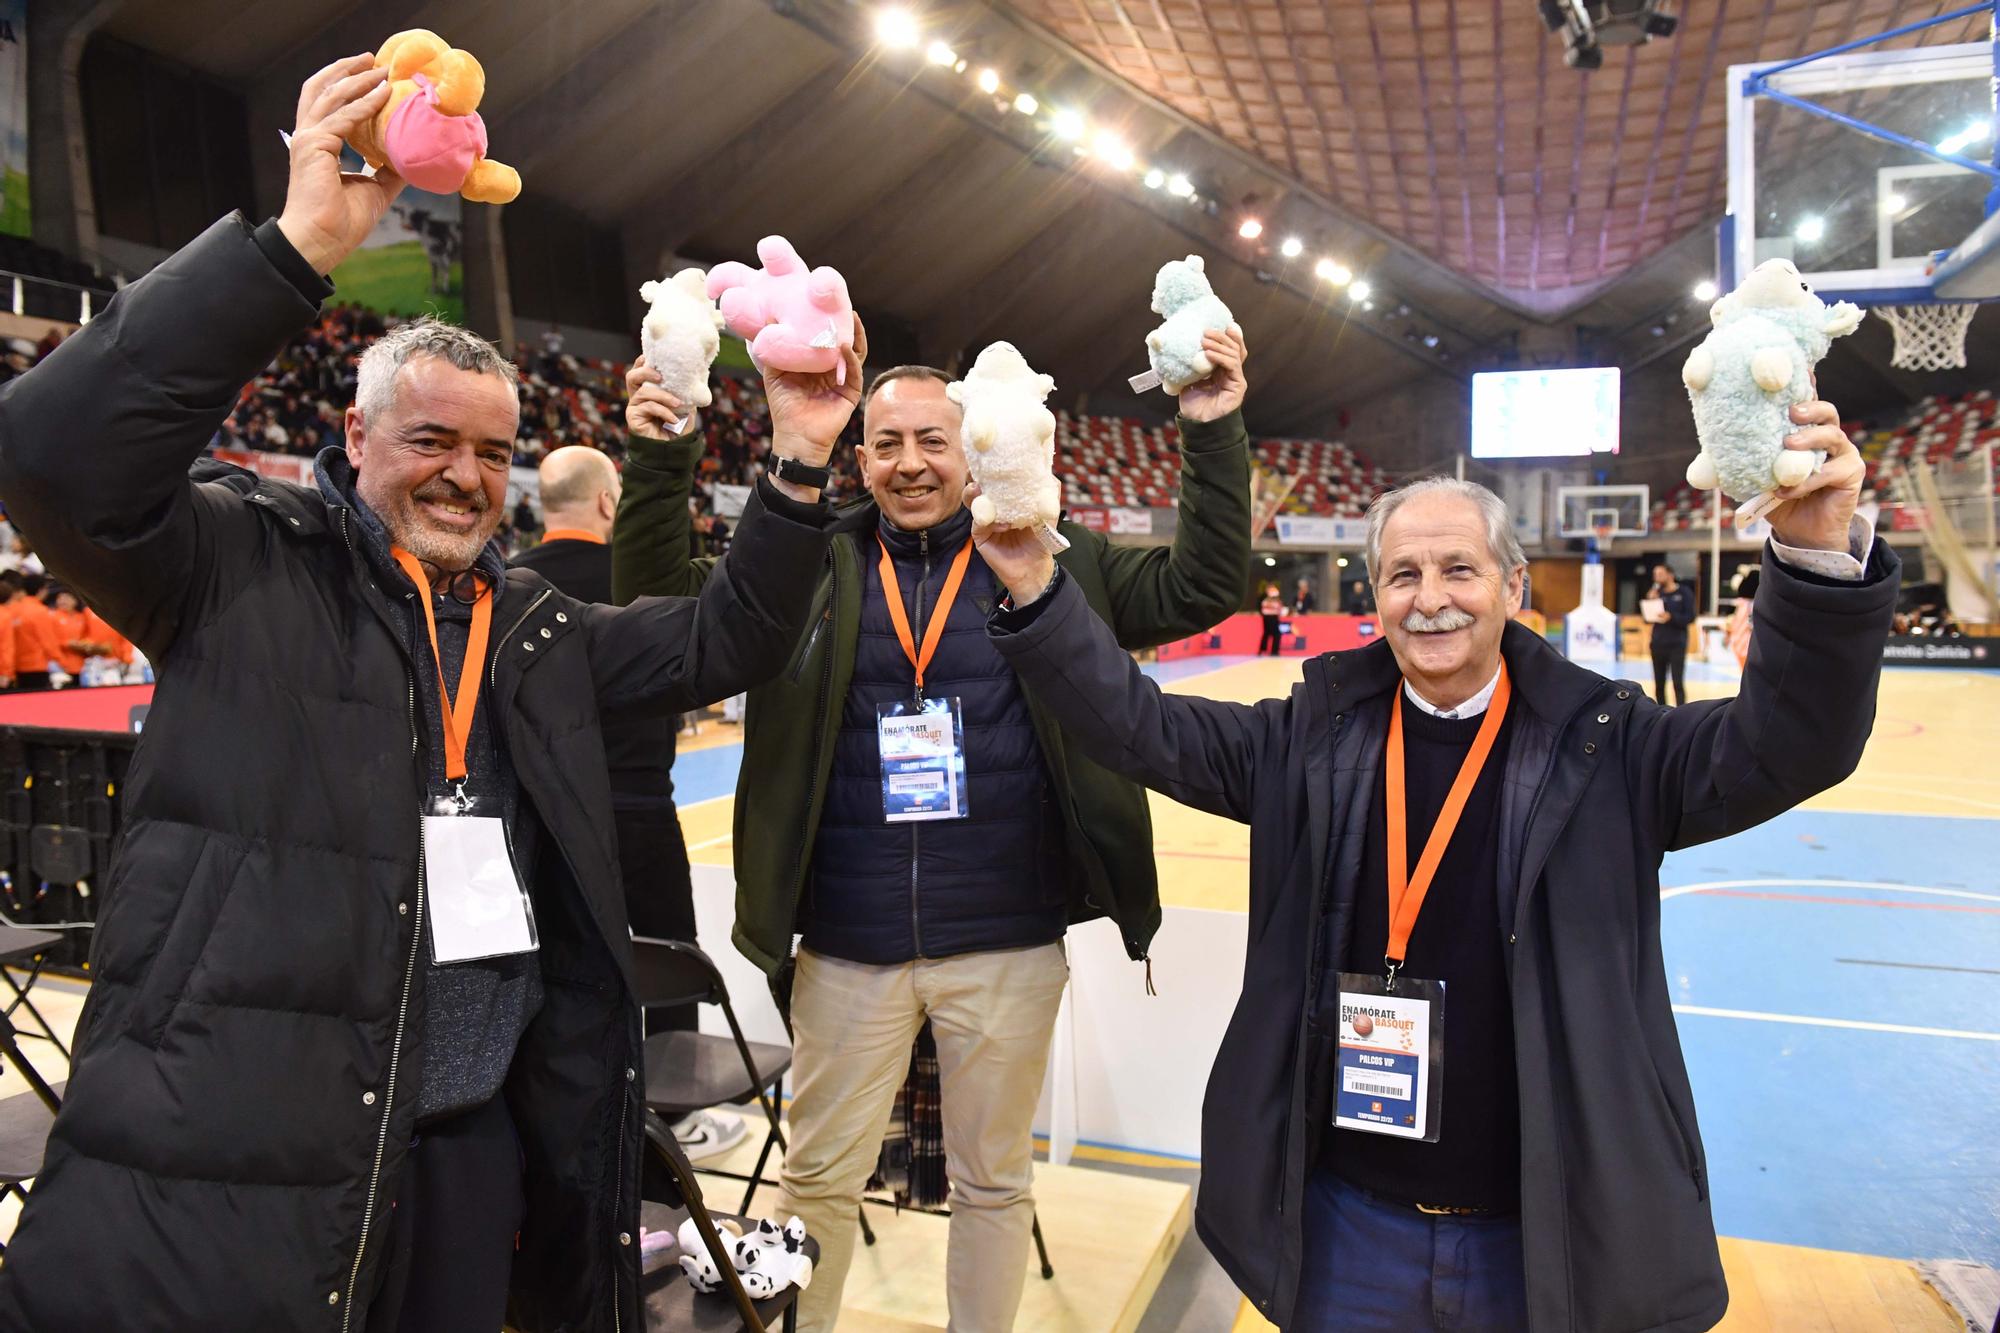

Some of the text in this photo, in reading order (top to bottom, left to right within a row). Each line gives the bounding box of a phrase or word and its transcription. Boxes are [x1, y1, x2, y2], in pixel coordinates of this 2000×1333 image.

[1342, 1005, 1396, 1020] ENAMÓRATE
[1375, 1017, 1414, 1030] BASQUET
[1359, 1054, 1395, 1067] PALCOS VIP
